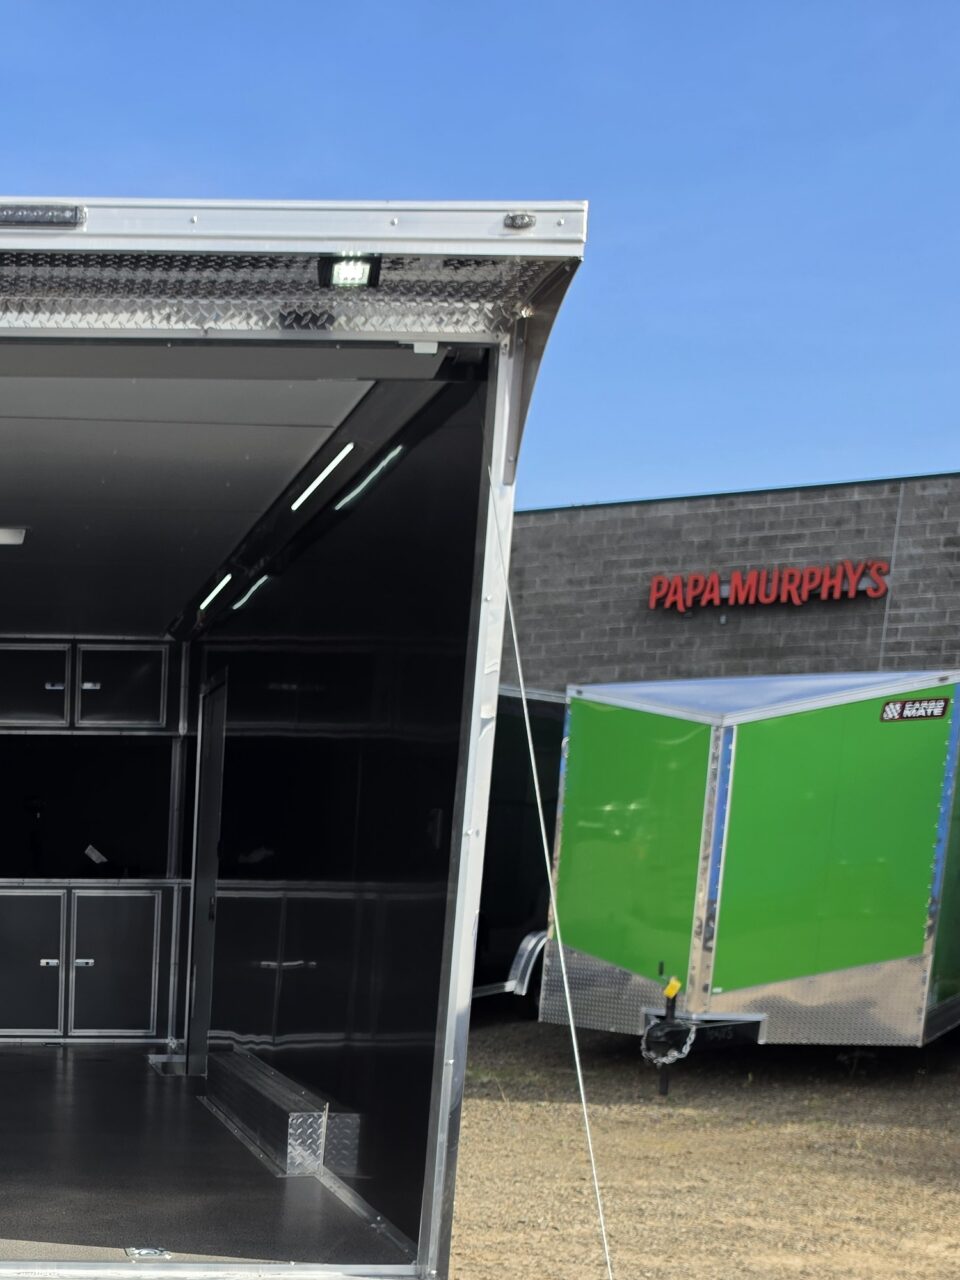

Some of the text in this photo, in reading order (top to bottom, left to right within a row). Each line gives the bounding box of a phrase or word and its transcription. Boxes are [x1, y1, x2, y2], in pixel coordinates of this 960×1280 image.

[648, 559, 889, 612] PAPA MURPHY'S
[902, 708, 943, 718] MATE
